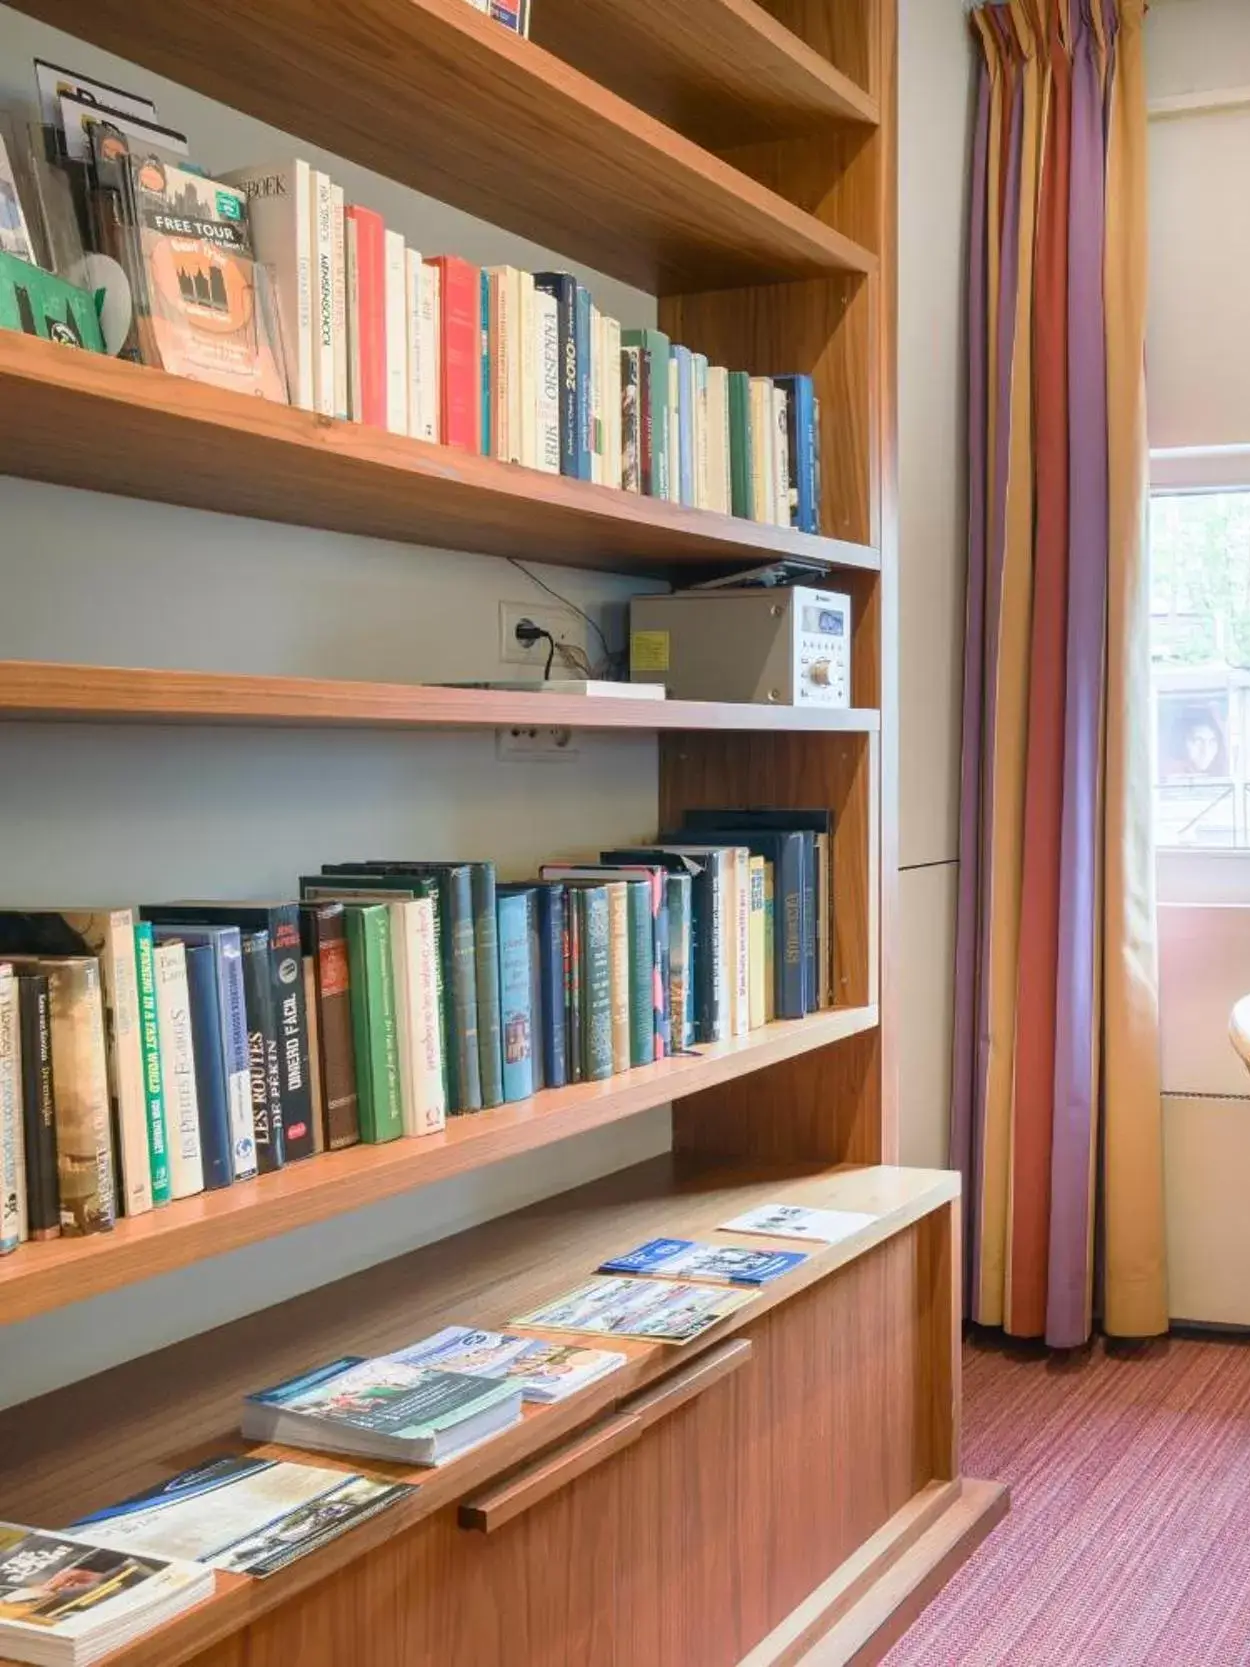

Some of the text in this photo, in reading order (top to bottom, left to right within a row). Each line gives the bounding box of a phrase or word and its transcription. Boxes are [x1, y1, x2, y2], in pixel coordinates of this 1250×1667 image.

[155, 215, 234, 240] FREE TOUR
[543, 312, 558, 467] ERIK ORSENNA
[247, 1031, 270, 1145] LES ROUTES
[285, 1038, 302, 1091] DINERO
